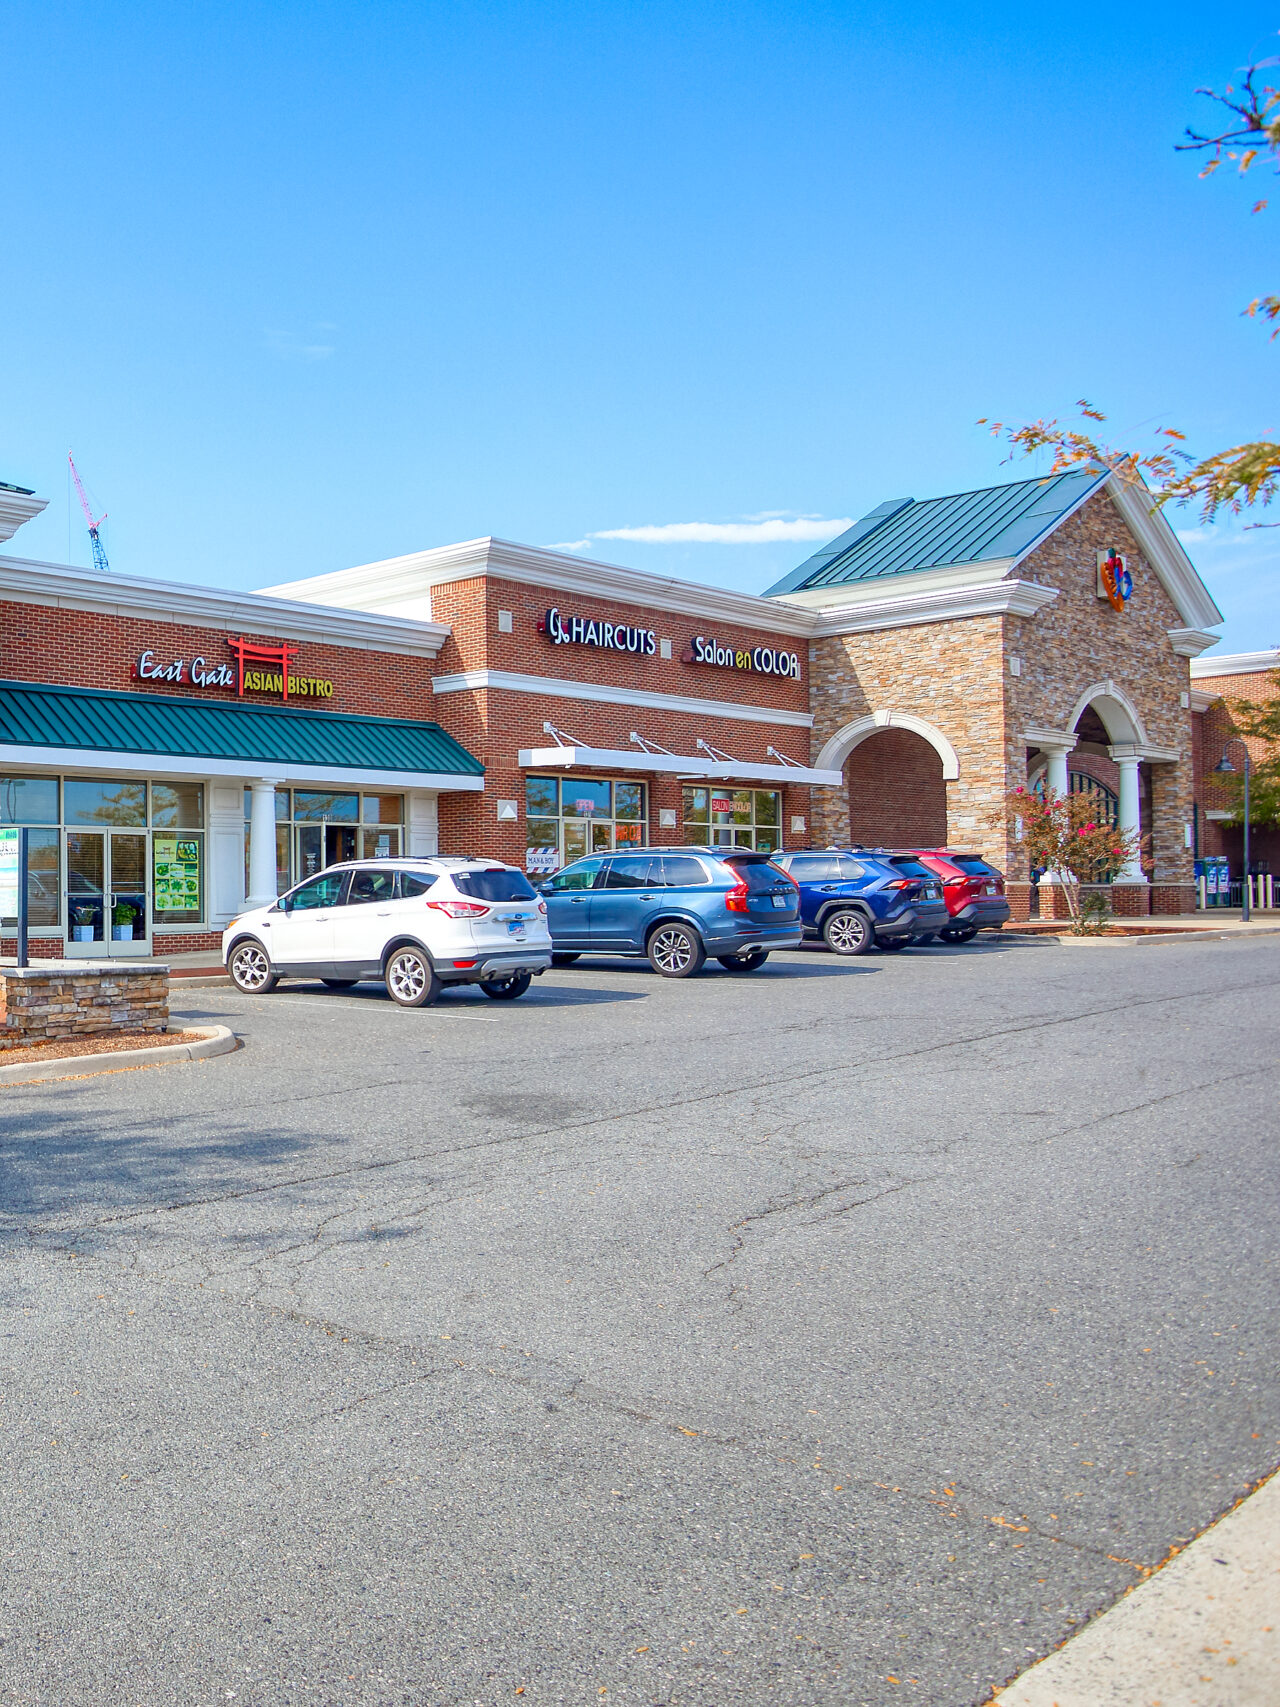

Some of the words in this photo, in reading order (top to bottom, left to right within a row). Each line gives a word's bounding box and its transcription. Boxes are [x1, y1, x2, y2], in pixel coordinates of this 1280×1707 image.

[572, 617, 656, 655] HAIRCUTS
[695, 636, 734, 667] Salon
[735, 650, 752, 670] en
[754, 647, 798, 679] COLOR
[139, 650, 184, 682] East
[191, 656, 234, 688] Gate
[243, 671, 283, 693] ASIAN
[287, 675, 334, 698] BISTRO
